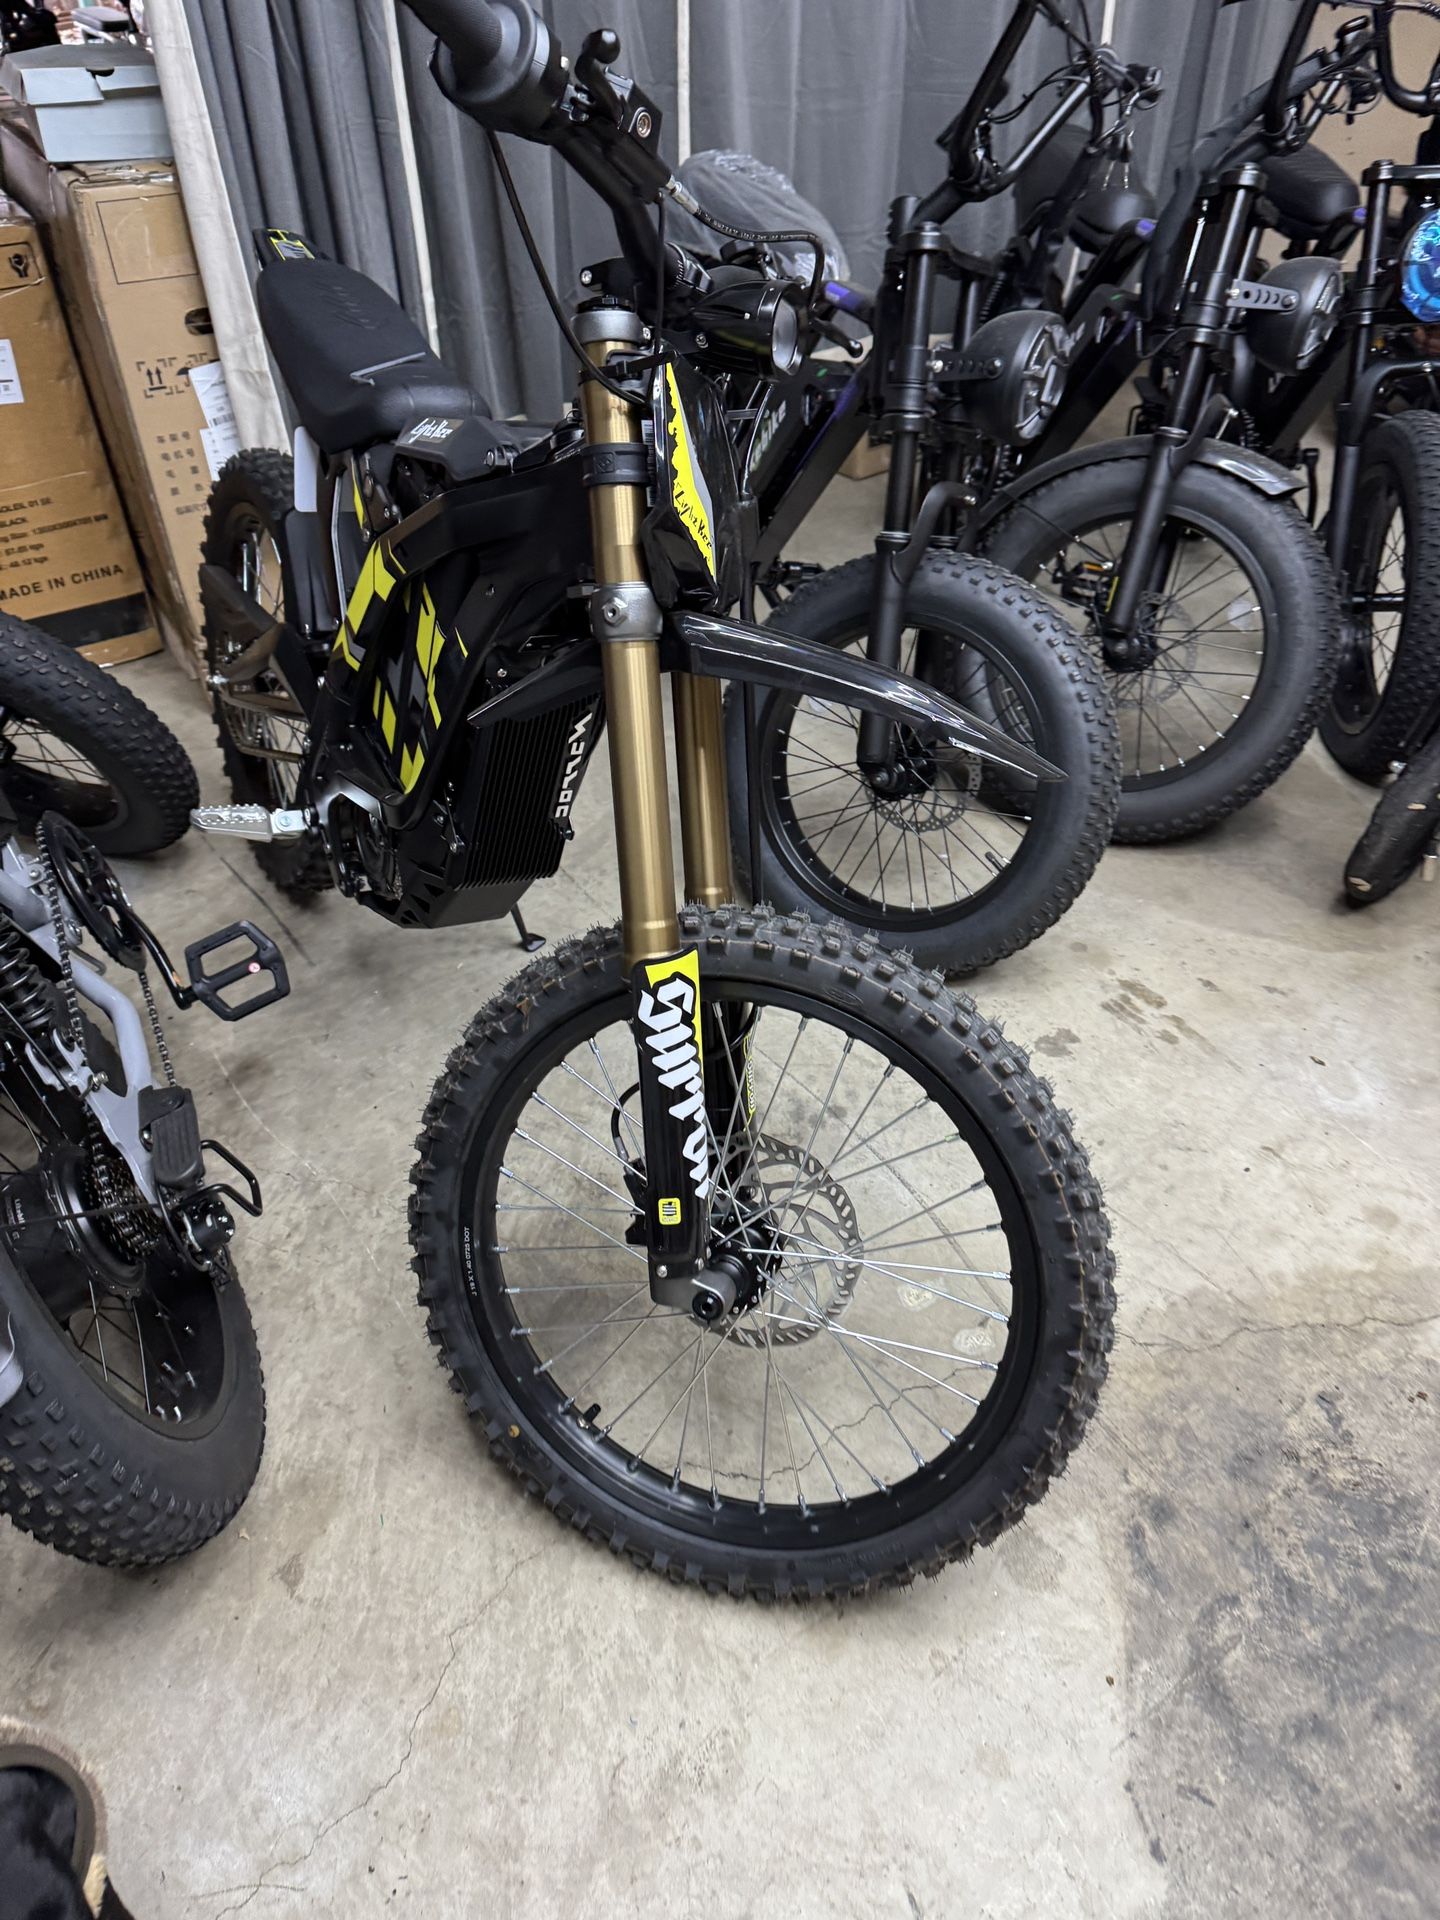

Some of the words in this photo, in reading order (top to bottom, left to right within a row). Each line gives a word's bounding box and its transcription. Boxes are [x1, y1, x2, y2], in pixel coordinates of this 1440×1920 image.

[0, 582, 43, 600] MADE
[48, 577, 66, 590] IN
[71, 564, 124, 584] CHINA
